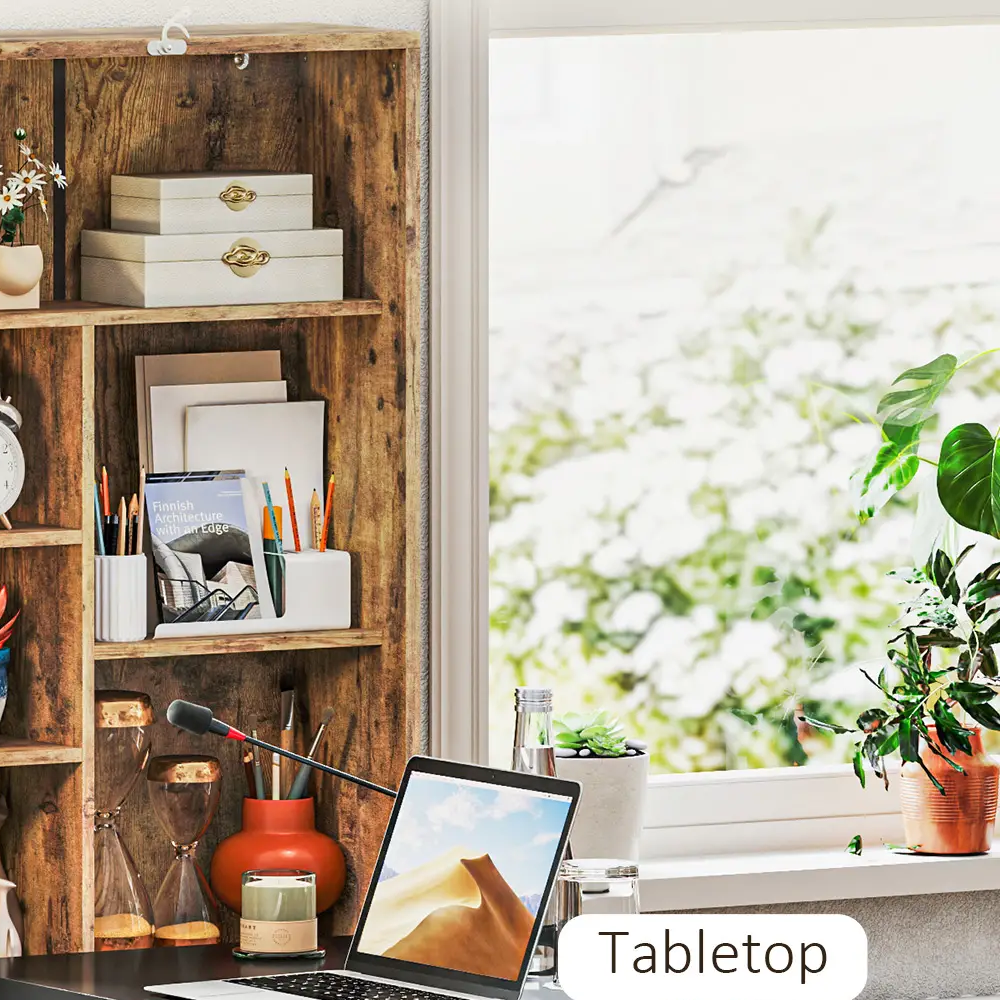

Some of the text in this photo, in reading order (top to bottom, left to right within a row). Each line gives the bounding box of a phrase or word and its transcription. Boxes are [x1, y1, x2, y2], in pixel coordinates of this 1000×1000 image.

[3, 444, 8, 454] 2
[153, 500, 194, 512] Finnish
[155, 512, 223, 523] Architecture
[156, 522, 230, 536] with an Edge
